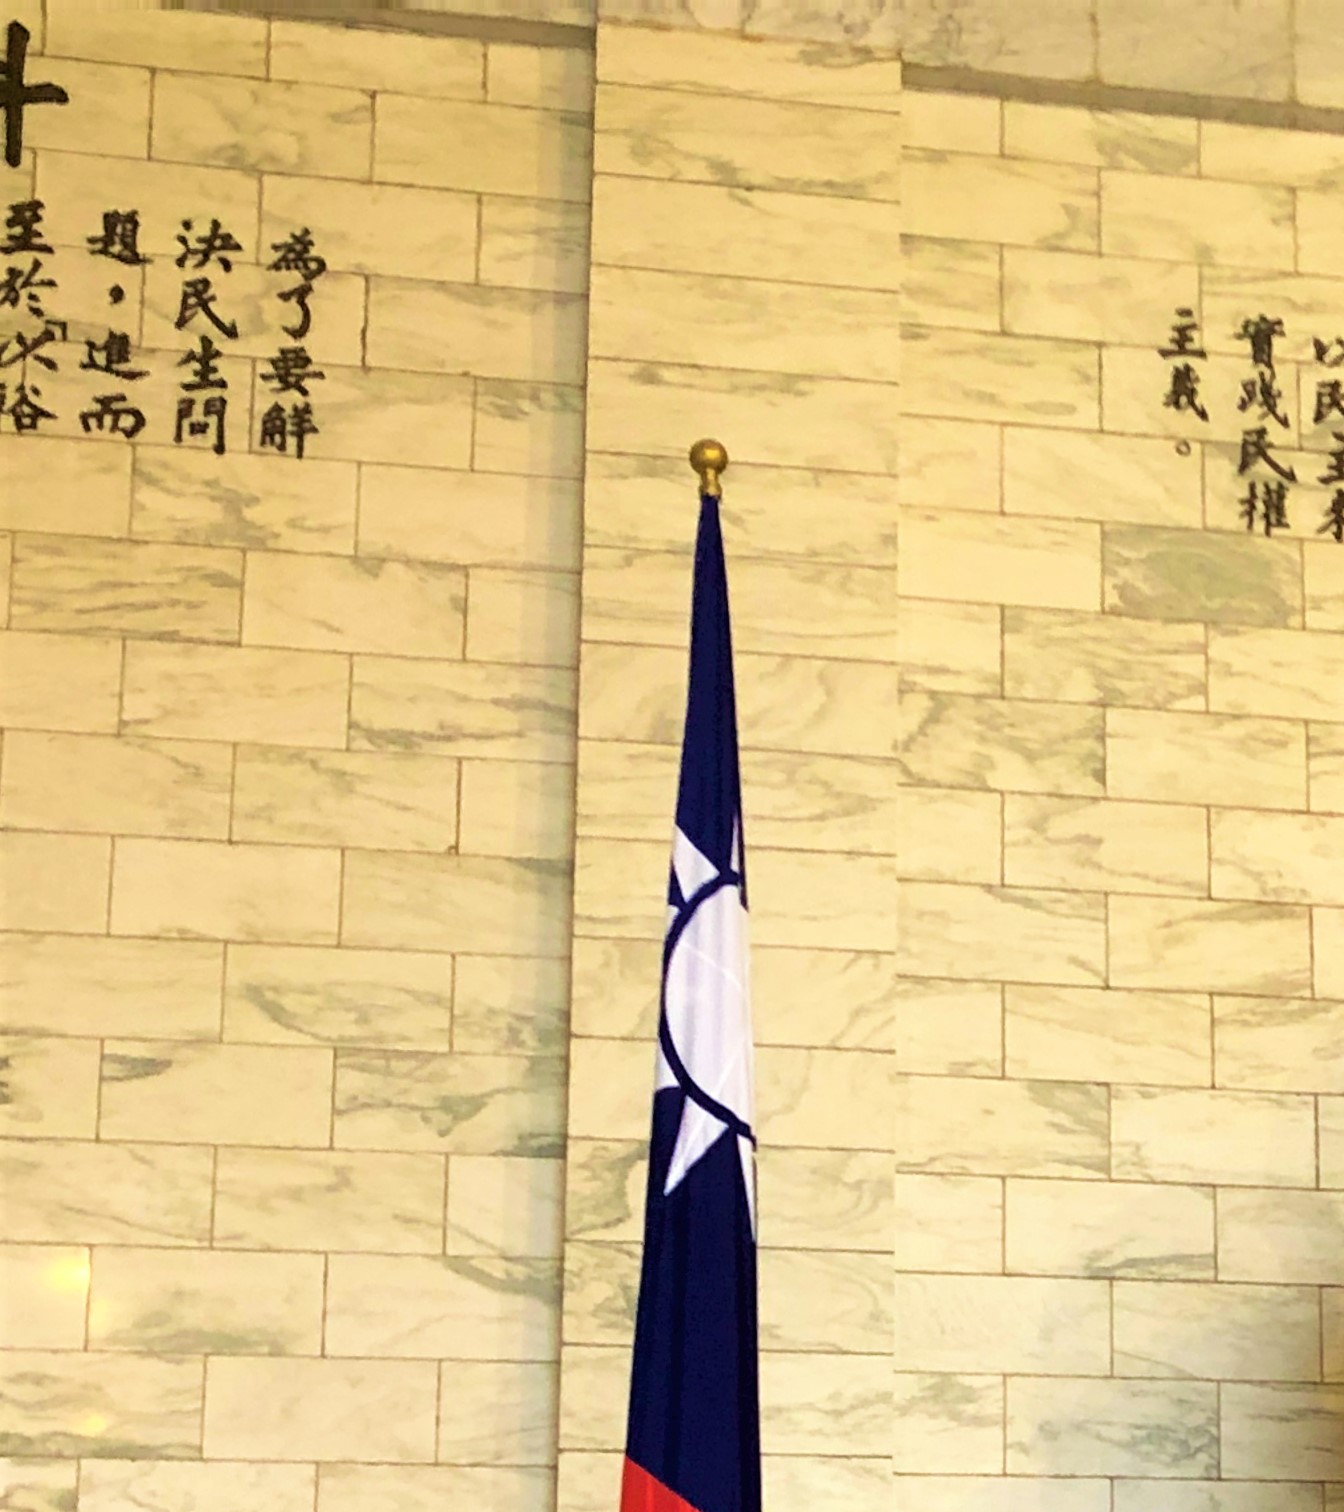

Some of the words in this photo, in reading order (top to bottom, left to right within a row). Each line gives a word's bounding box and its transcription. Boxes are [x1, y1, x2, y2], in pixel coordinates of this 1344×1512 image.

[174, 219, 242, 454] 決民生問
[260, 227, 327, 458] 為了要解
